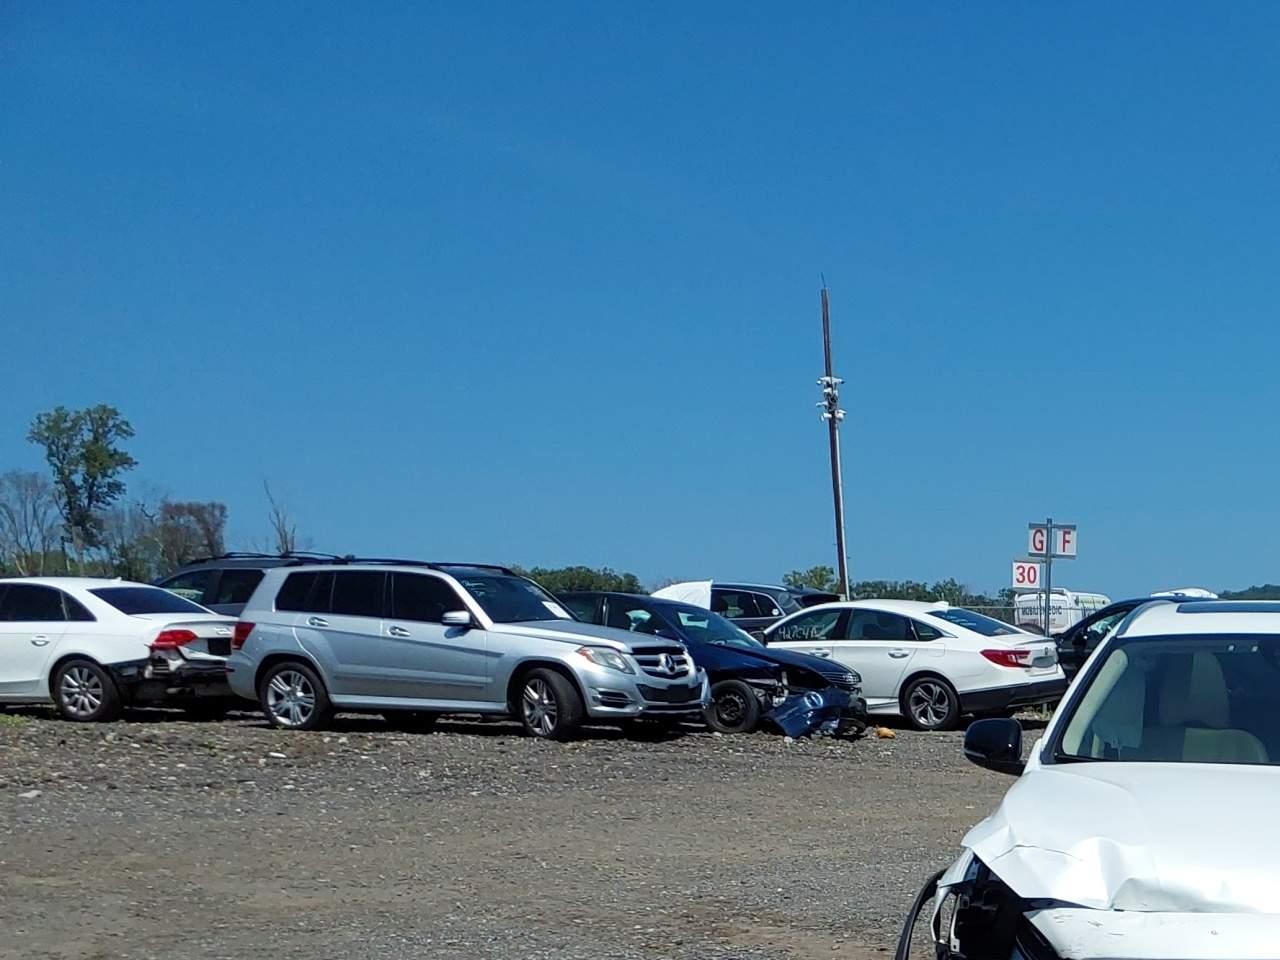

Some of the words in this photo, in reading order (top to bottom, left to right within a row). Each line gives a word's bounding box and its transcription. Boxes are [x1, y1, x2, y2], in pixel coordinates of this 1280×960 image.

[1032, 528, 1044, 551] G
[1062, 530, 1071, 552] F
[1016, 565, 1037, 584] 30
